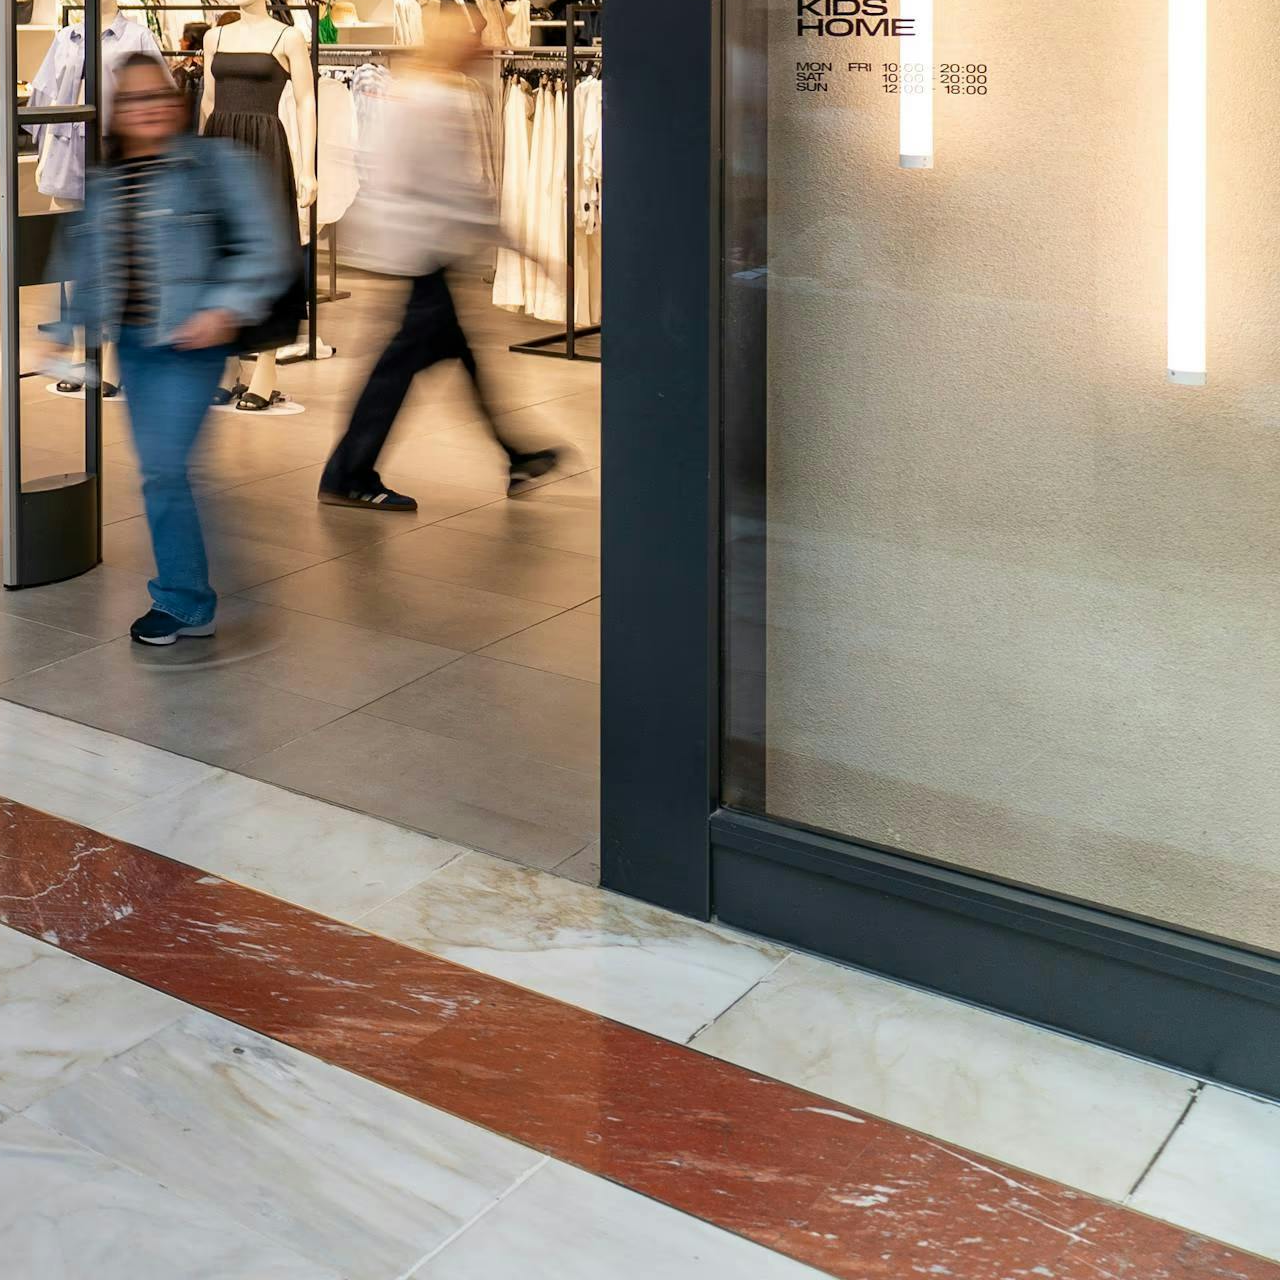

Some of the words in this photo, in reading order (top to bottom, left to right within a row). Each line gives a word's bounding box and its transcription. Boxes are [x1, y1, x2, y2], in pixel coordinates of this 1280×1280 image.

[797, 18, 915, 37] HOME
[796, 62, 832, 72] MON
[848, 63, 872, 72] FRI
[882, 63, 924, 73] 10:00
[940, 64, 987, 74] 20:00
[796, 73, 824, 82] SAT
[882, 74, 924, 83] 10:00
[940, 74, 987, 84] 20:00
[796, 83, 828, 92] SUN
[882, 84, 924, 94] 12:00
[945, 85, 987, 95] 18:00
